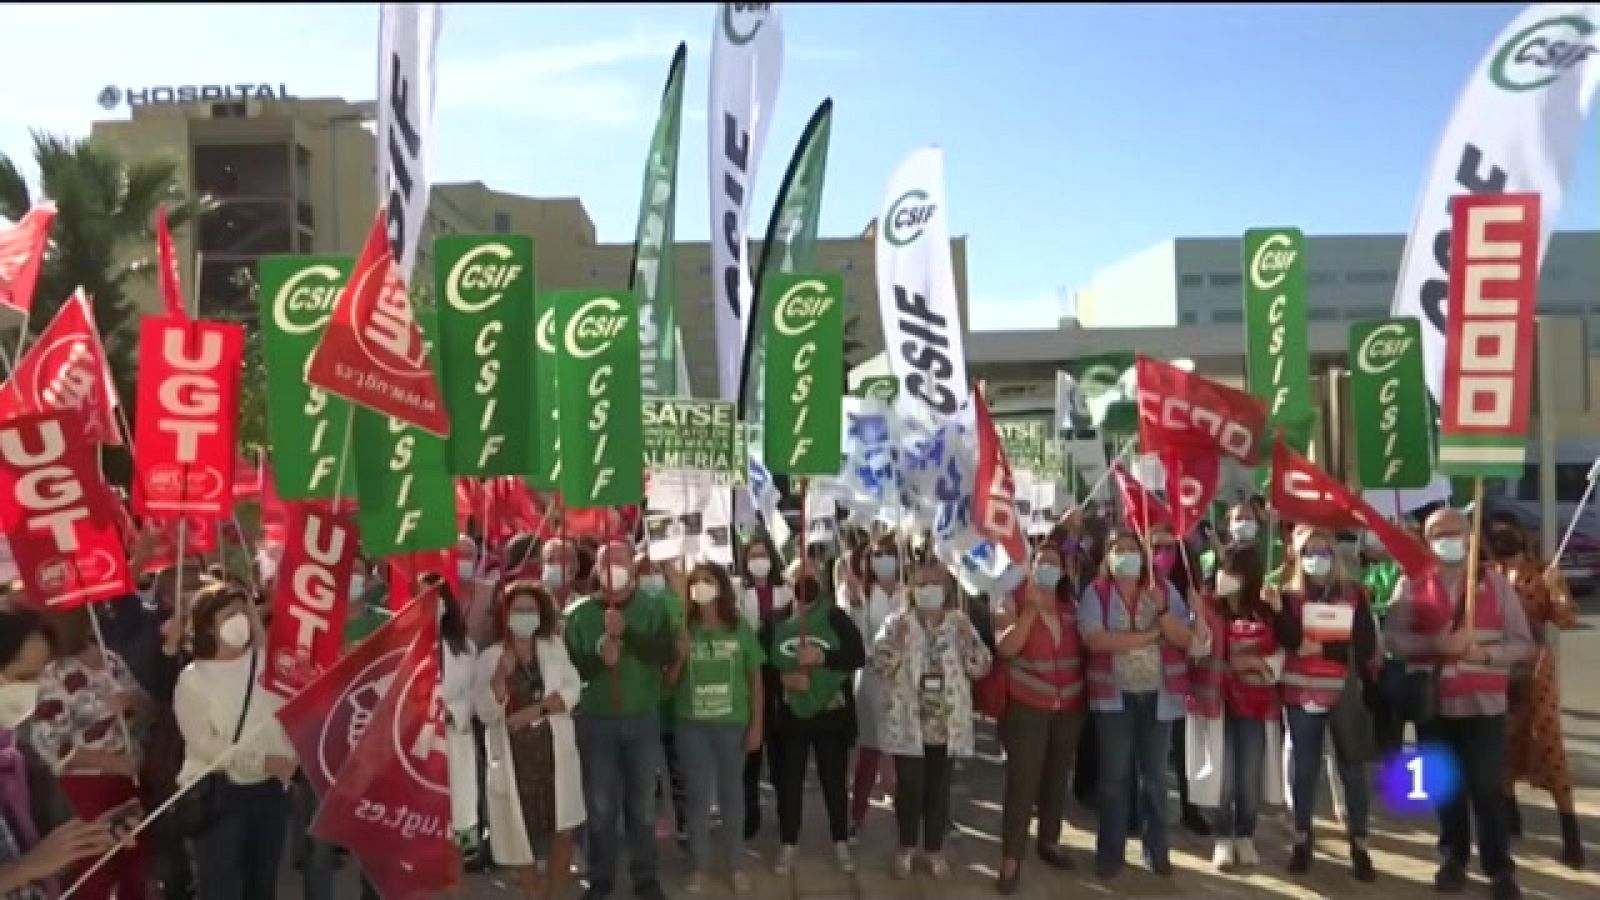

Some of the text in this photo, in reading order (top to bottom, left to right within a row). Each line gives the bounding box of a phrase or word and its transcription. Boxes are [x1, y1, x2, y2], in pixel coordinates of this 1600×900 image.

[127, 82, 297, 105] HOSPITAL
[458, 263, 523, 292] CSIF
[1457, 206, 1525, 426] CCOO
[158, 327, 223, 464] UGT
[474, 320, 504, 469] CSIF
[641, 402, 731, 426] SATSE
[788, 342, 817, 467] CSIF
[894, 284, 958, 415] CSIF
[1268, 295, 1288, 416] CSIF
[0, 419, 91, 552] UGT
[588, 366, 616, 500] CSIF
[1378, 378, 1401, 484] CSIF
[288, 513, 347, 660] UGT
